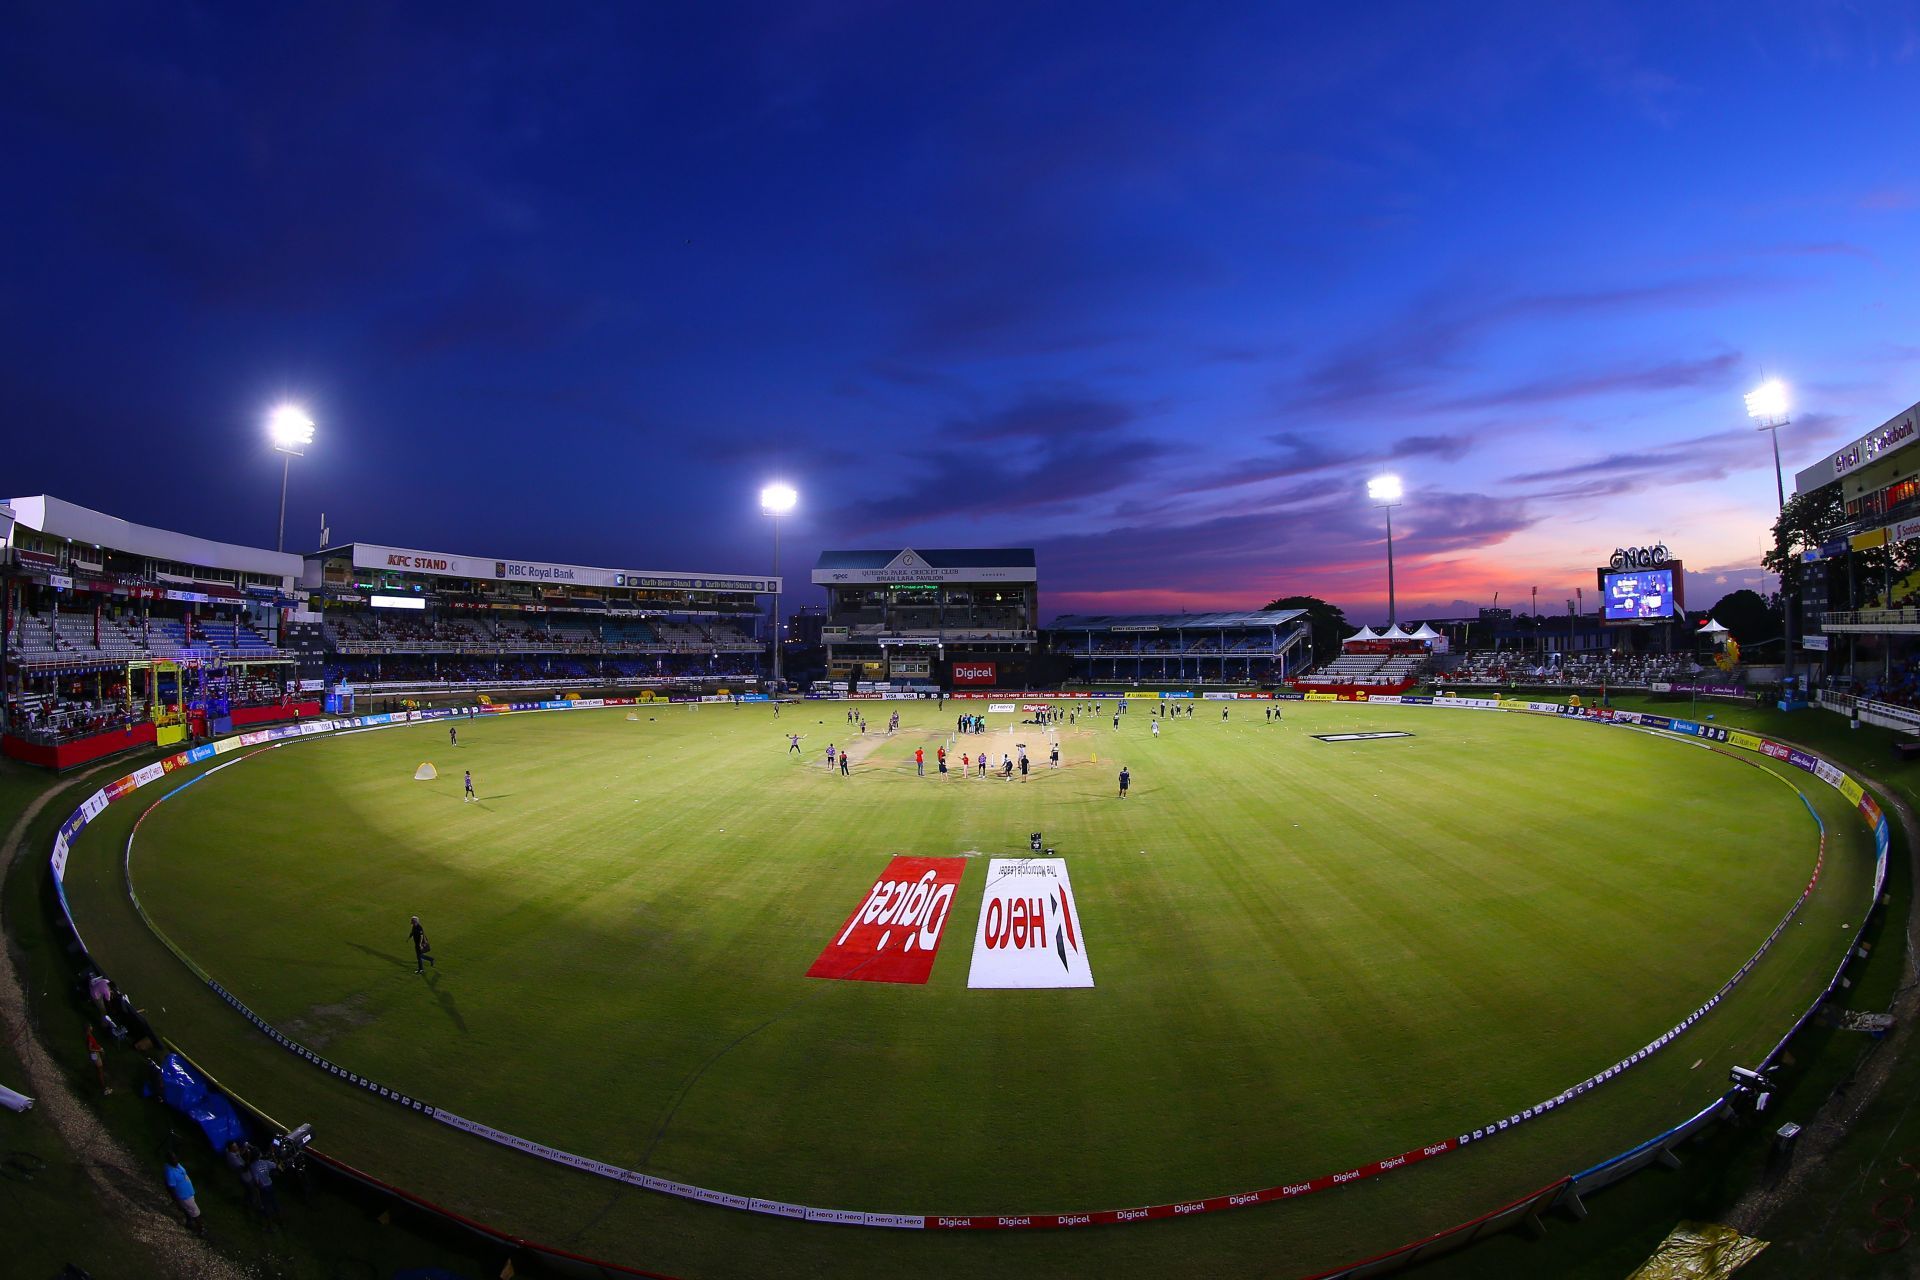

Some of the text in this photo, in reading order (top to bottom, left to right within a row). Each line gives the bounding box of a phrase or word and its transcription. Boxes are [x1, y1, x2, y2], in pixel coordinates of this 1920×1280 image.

[1874, 418, 1913, 452] Scotiabank
[1836, 447, 1860, 472] Shell
[387, 555, 447, 570] KFC STAND
[508, 565, 574, 579] RBC Royal Bank
[956, 667, 992, 679] Digicel
[1047, 866, 1057, 877] The
[837, 869, 955, 953] Digicel
[985, 897, 1047, 950] Hero
[477, 1126, 489, 1134] Hero
[517, 1140, 530, 1148] Hero
[1424, 1142, 1448, 1156] Digicel
[537, 1147, 550, 1155] Hero
[560, 1154, 573, 1162] Hero
[1380, 1156, 1405, 1169] Digicel
[581, 1161, 595, 1169] Hero
[1333, 1170, 1360, 1183] Digicel
[652, 1180, 668, 1188] Hero
[1283, 1182, 1311, 1195] Digicel
[677, 1186, 693, 1194] Hero
[703, 1192, 720, 1200] Hero
[1229, 1193, 1259, 1205] Digicel
[729, 1198, 746, 1206] Hero
[1174, 1202, 1205, 1213] Digicel
[816, 1211, 833, 1219] Hero
[1117, 1208, 1149, 1220] Digicel
[938, 1218, 971, 1227] Digicel
[998, 1217, 1031, 1227] Digicel
[1058, 1215, 1090, 1226] Digicel
